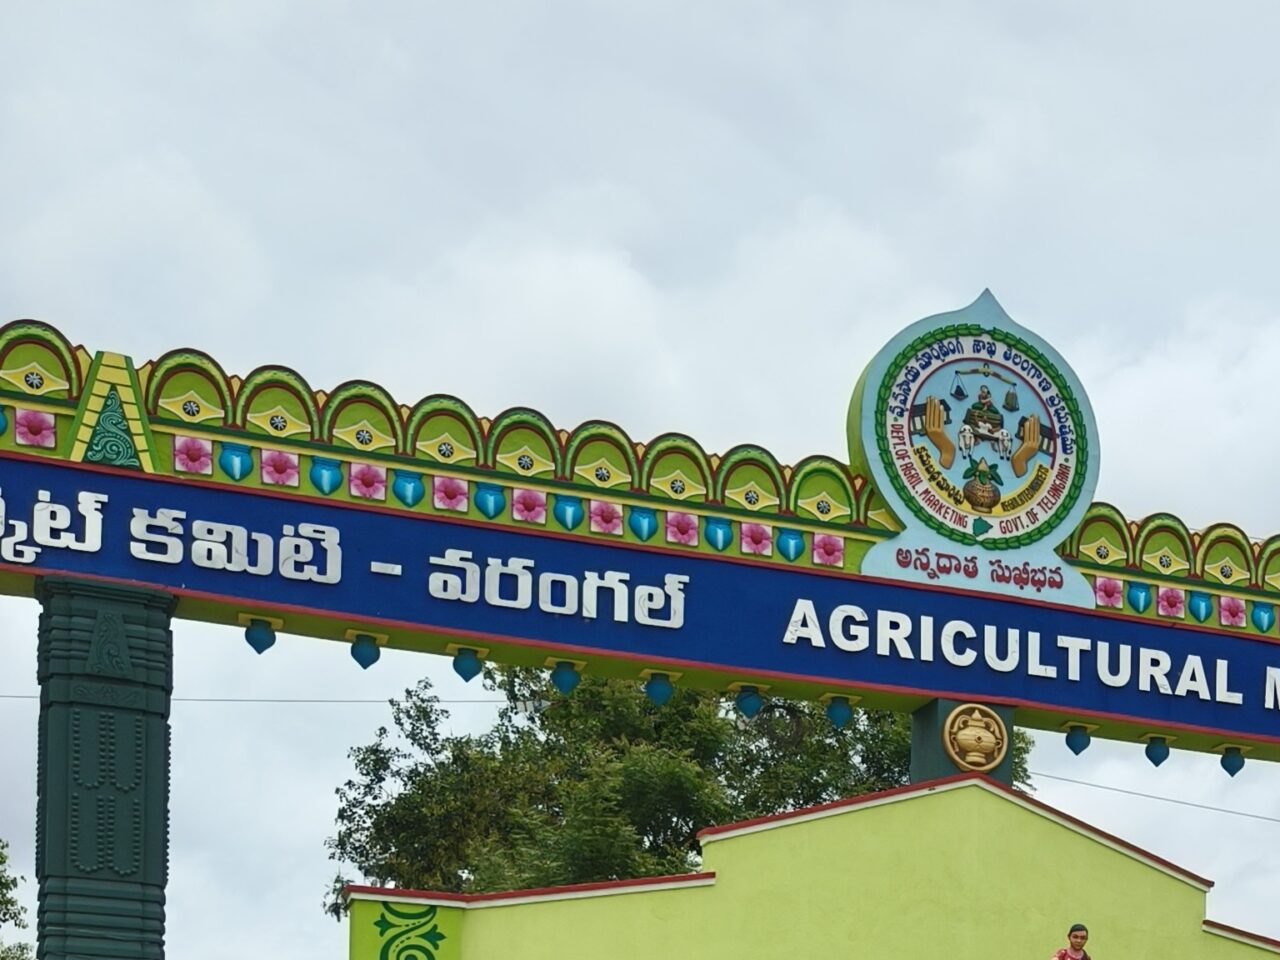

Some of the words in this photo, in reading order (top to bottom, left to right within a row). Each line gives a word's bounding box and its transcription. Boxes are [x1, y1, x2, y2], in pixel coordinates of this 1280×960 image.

[919, 487, 968, 529] MARKETING
[999, 516, 1029, 535] GOVT.
[1025, 507, 1040, 524] OF
[1037, 463, 1071, 514] TELANGANA
[429, 549, 690, 629] వరంగల్
[896, 547, 979, 580] అన్నదాత
[988, 559, 1064, 592] సుఖీభవ
[782, 598, 1244, 705] AGRICULTURAL
